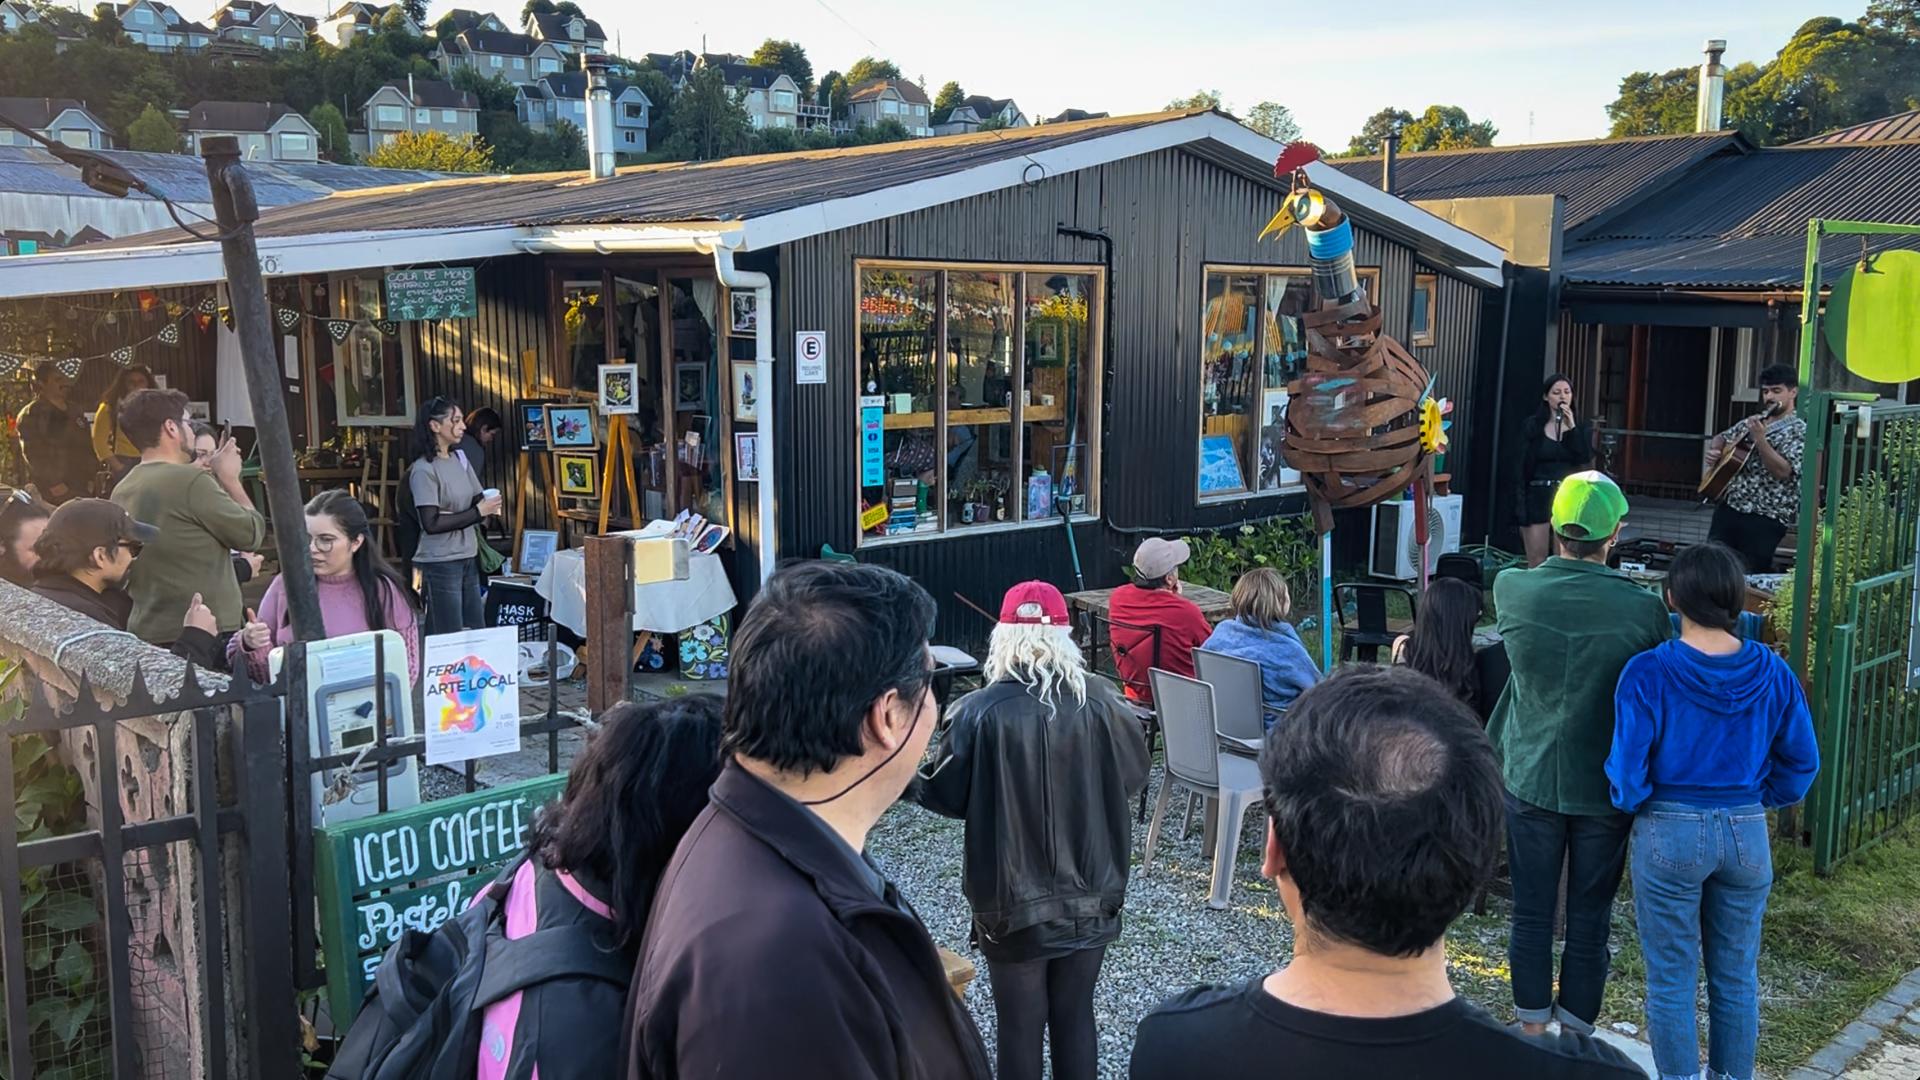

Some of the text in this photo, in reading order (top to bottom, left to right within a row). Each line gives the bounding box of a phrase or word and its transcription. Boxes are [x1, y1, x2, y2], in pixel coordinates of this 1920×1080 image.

[387, 269, 472, 282] COLA DE MONO
[806, 341, 817, 355] E
[499, 604, 536, 616] HASK
[427, 662, 467, 677] FERIA
[427, 674, 516, 696] ARTE LOCAL
[353, 826, 419, 887] ICED
[429, 798, 530, 871] COFFEE
